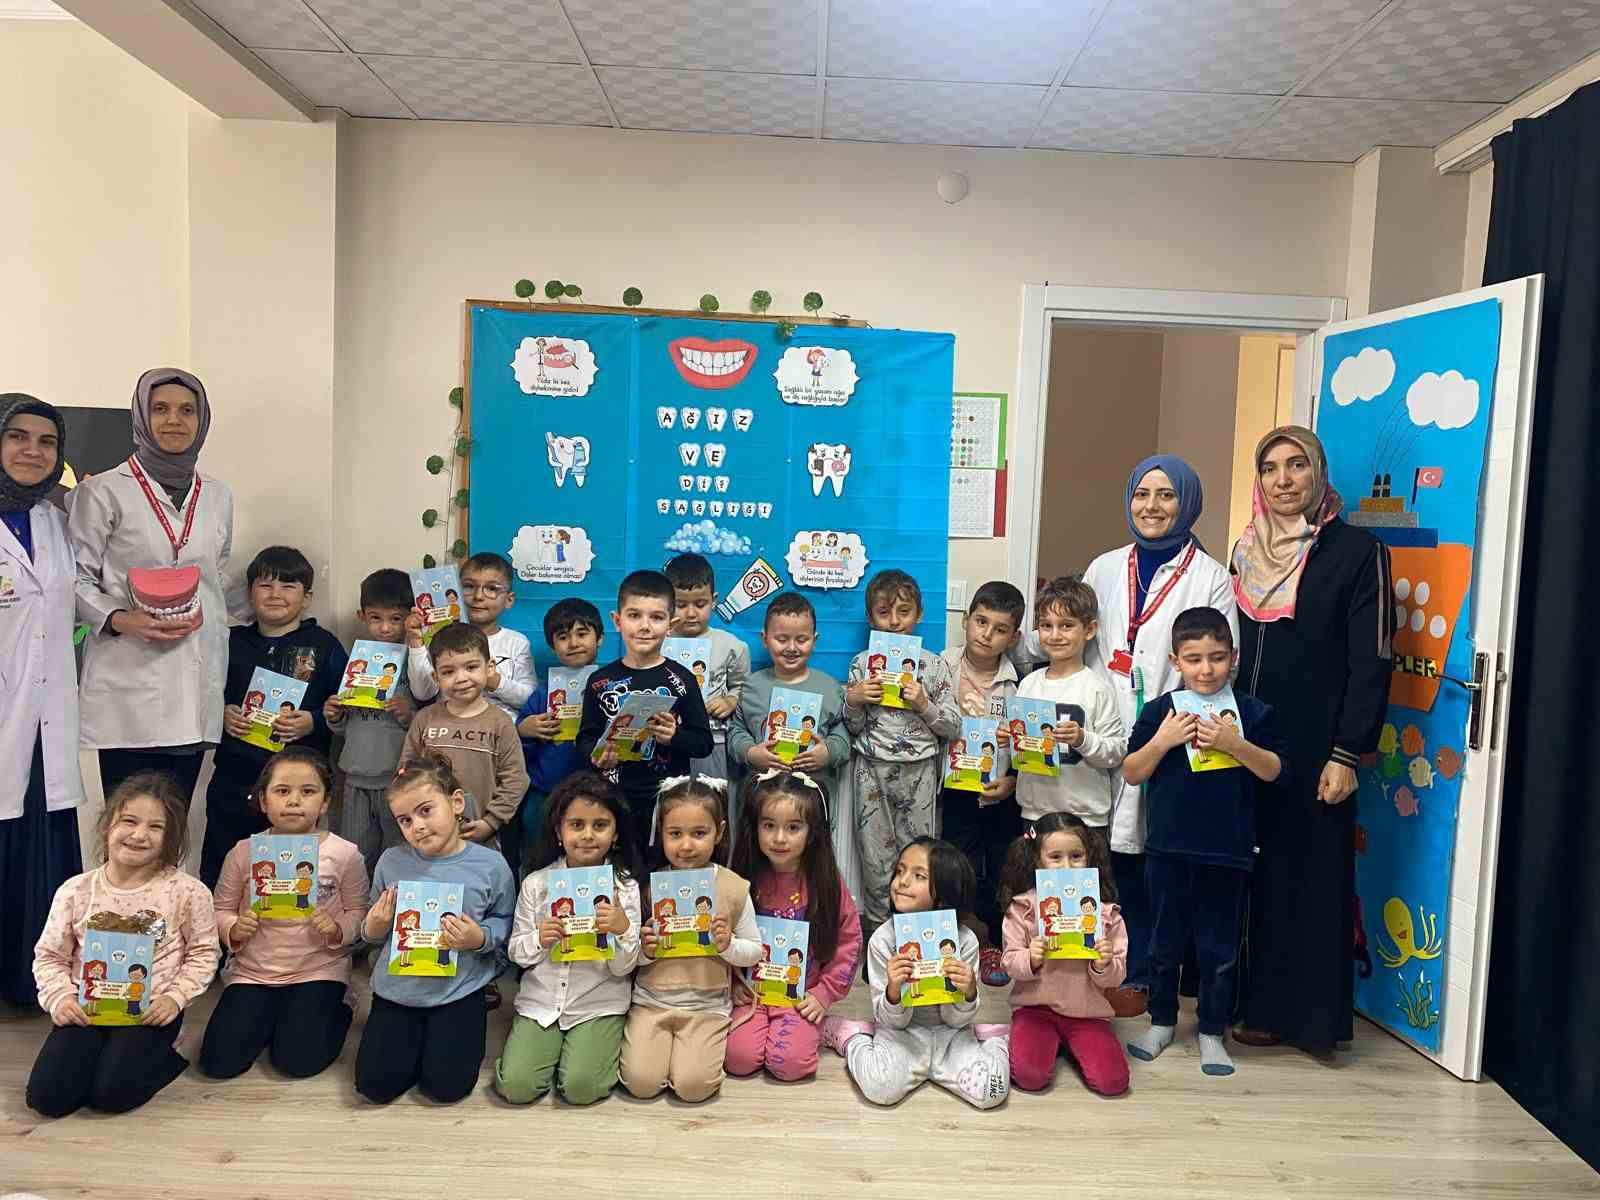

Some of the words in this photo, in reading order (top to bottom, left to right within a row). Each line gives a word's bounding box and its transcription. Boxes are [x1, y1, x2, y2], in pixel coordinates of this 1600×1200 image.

[663, 412, 748, 426] AĞIZ
[685, 450, 721, 462] VE
[683, 478, 725, 489] DİŞ
[660, 502, 768, 515] SAĞLIĞI
